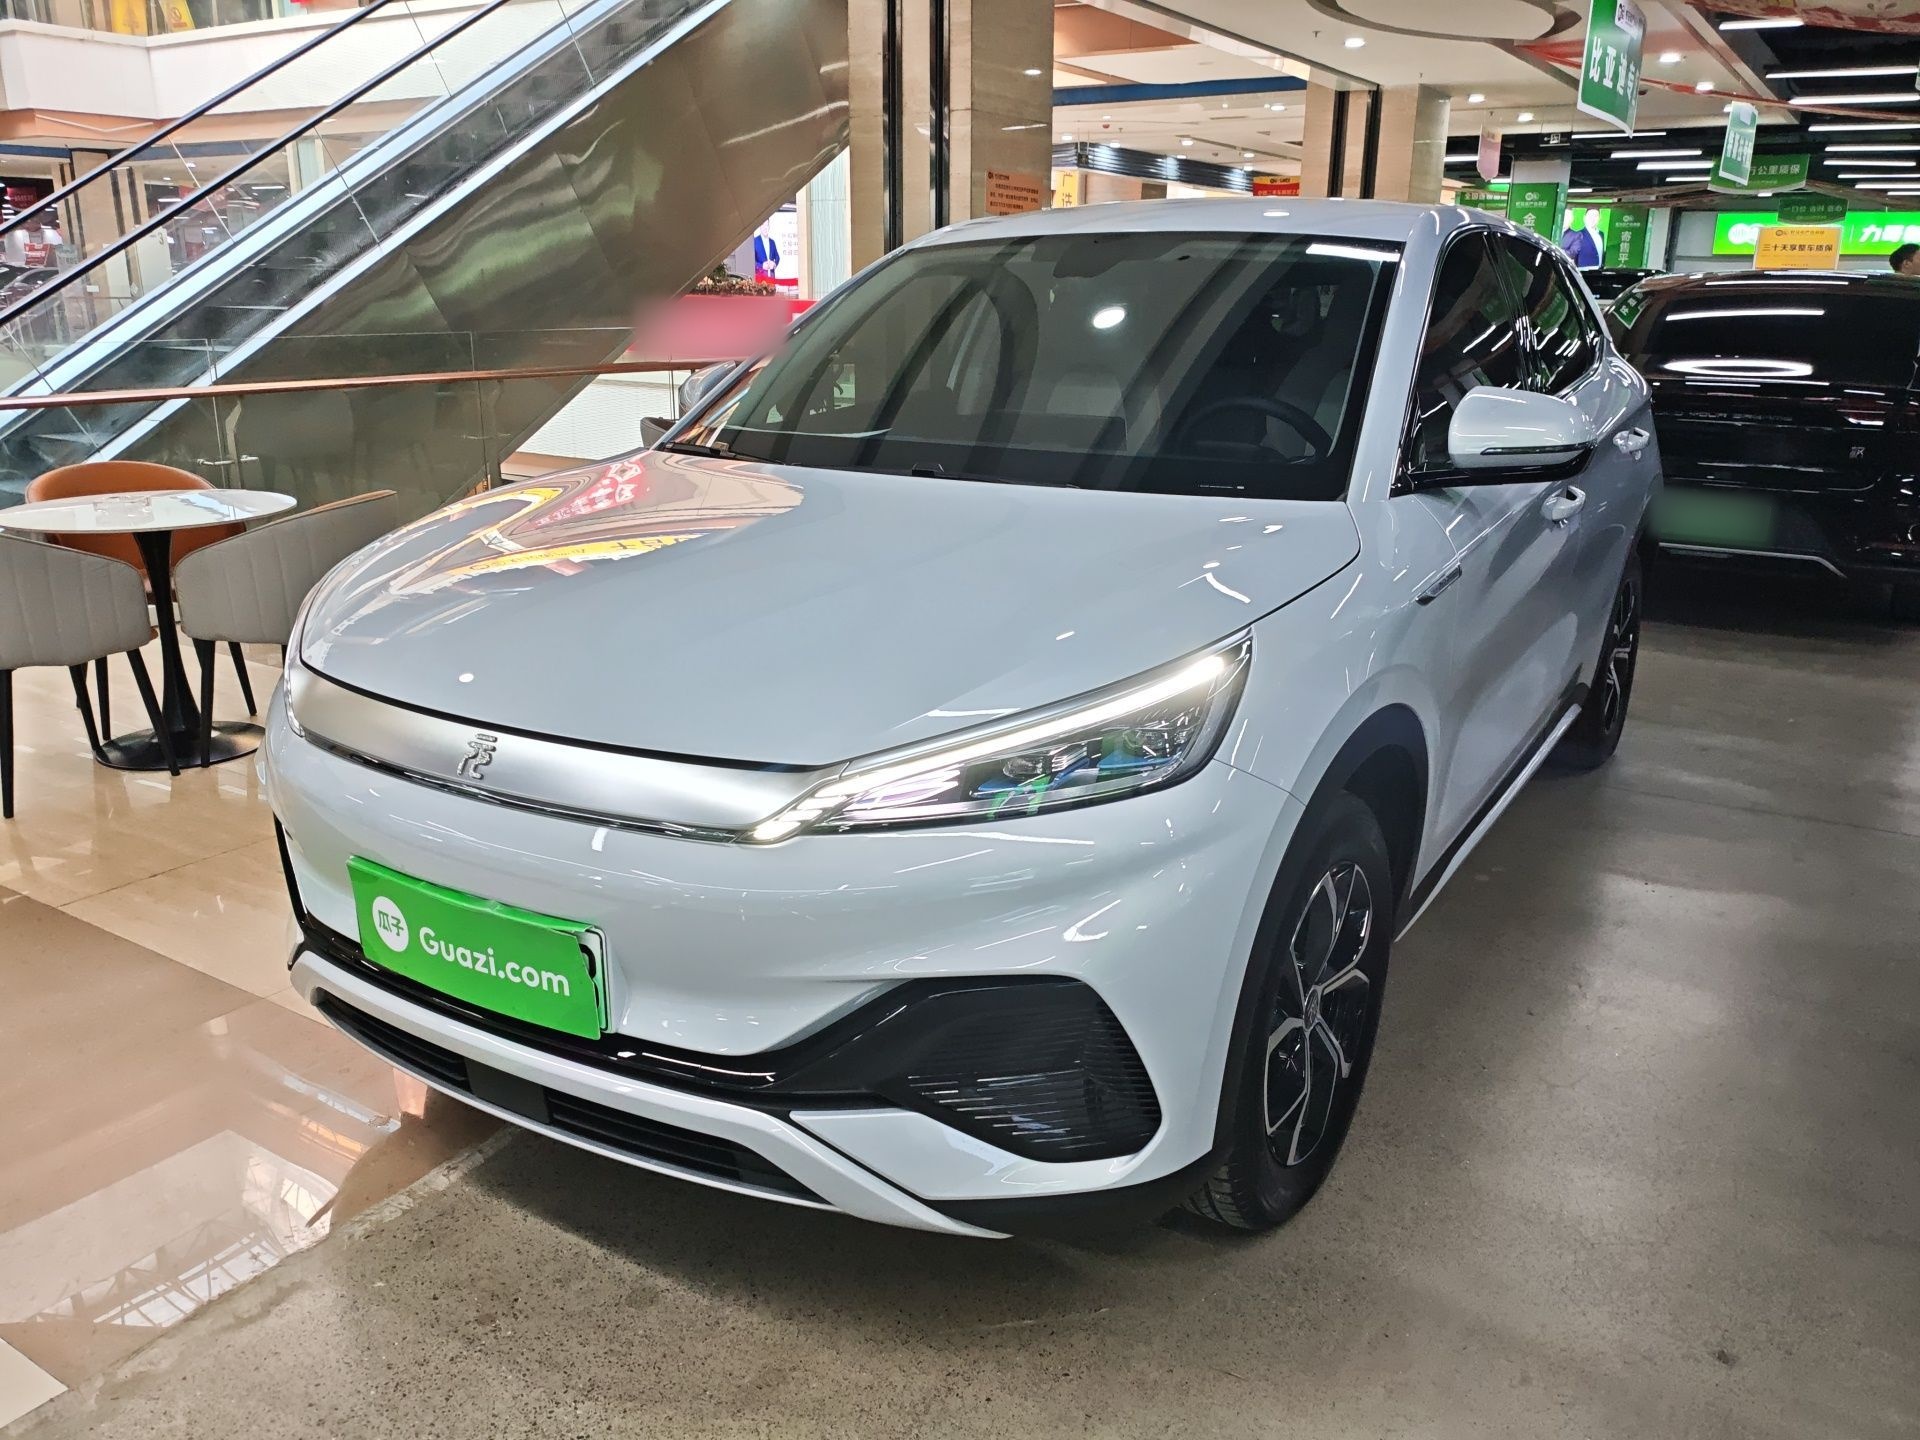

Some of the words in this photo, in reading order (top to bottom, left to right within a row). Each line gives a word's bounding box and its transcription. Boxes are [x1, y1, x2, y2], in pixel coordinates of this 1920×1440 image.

[1589, 36, 1640, 107] 比亚迪专
[1618, 231, 1632, 267] 寄售平
[377, 909, 404, 936] 瓜子
[419, 926, 570, 996] Guazi.com
